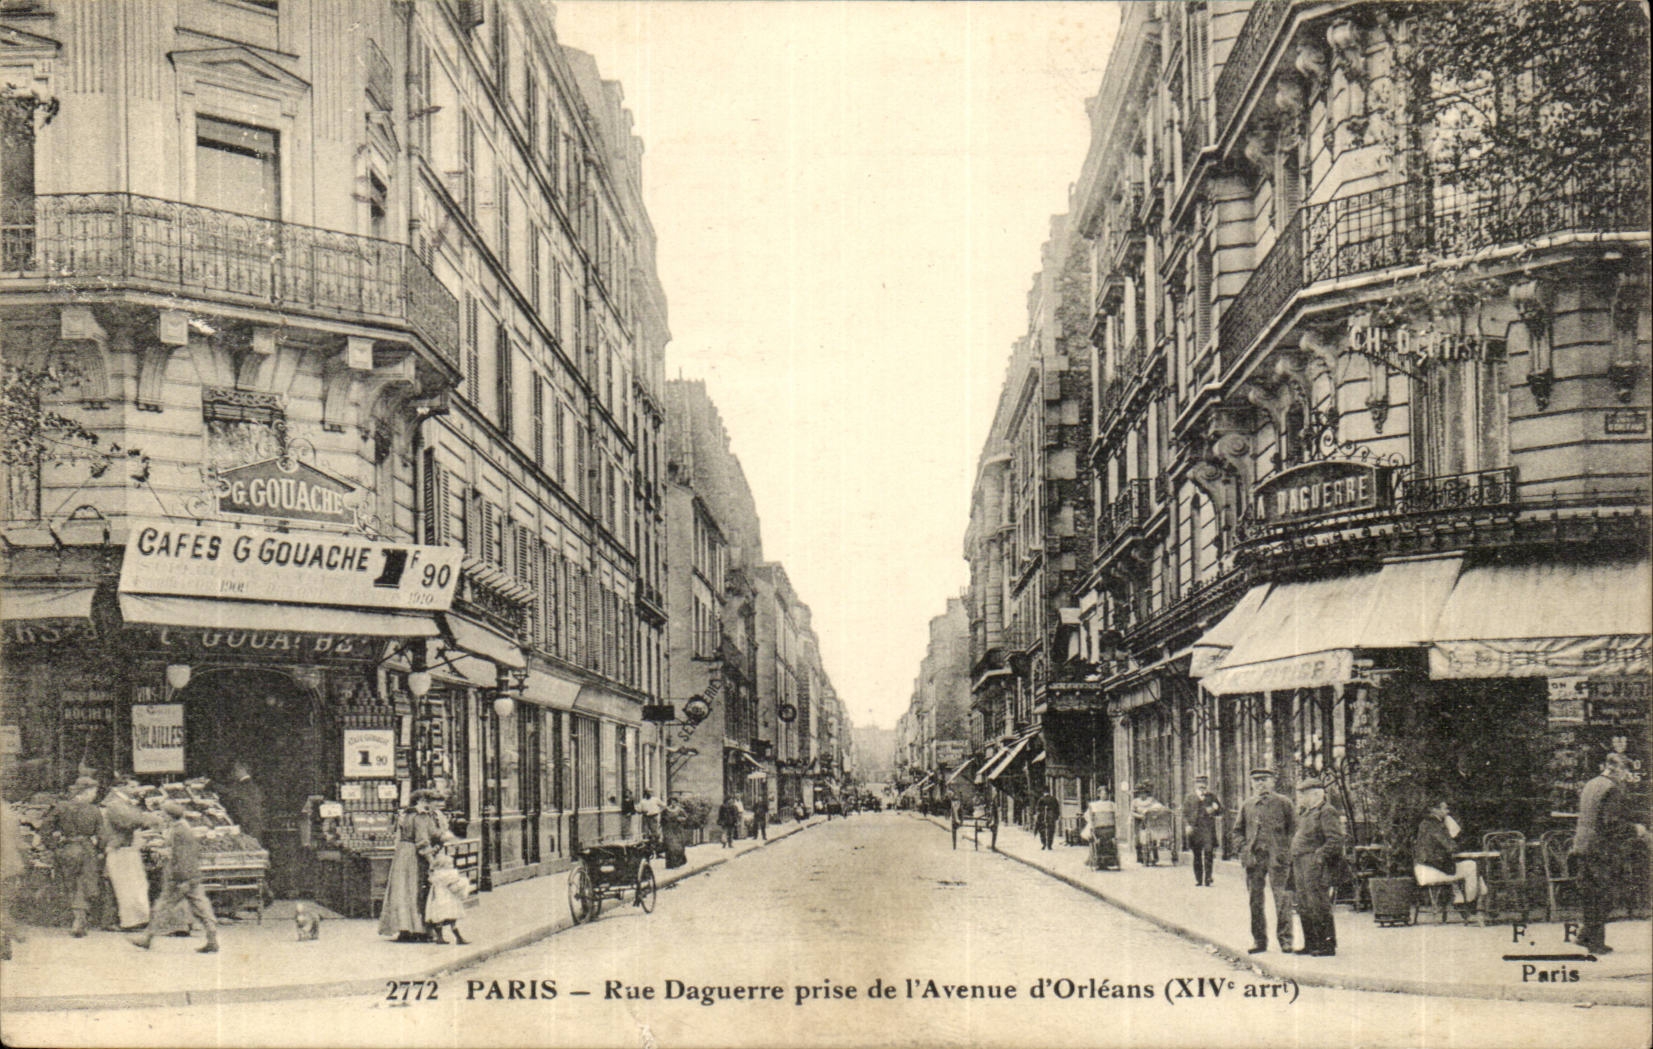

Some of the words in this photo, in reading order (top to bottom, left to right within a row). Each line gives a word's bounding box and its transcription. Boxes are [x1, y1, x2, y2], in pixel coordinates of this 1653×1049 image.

[231, 481, 250, 505] G.
[250, 478, 344, 514] GOUACHE
[1256, 494, 1266, 520] A
[1276, 474, 1370, 516] DAGUERRE
[232, 535, 252, 563] G
[258, 537, 371, 572] GOUACHE
[421, 563, 451, 588] 90
